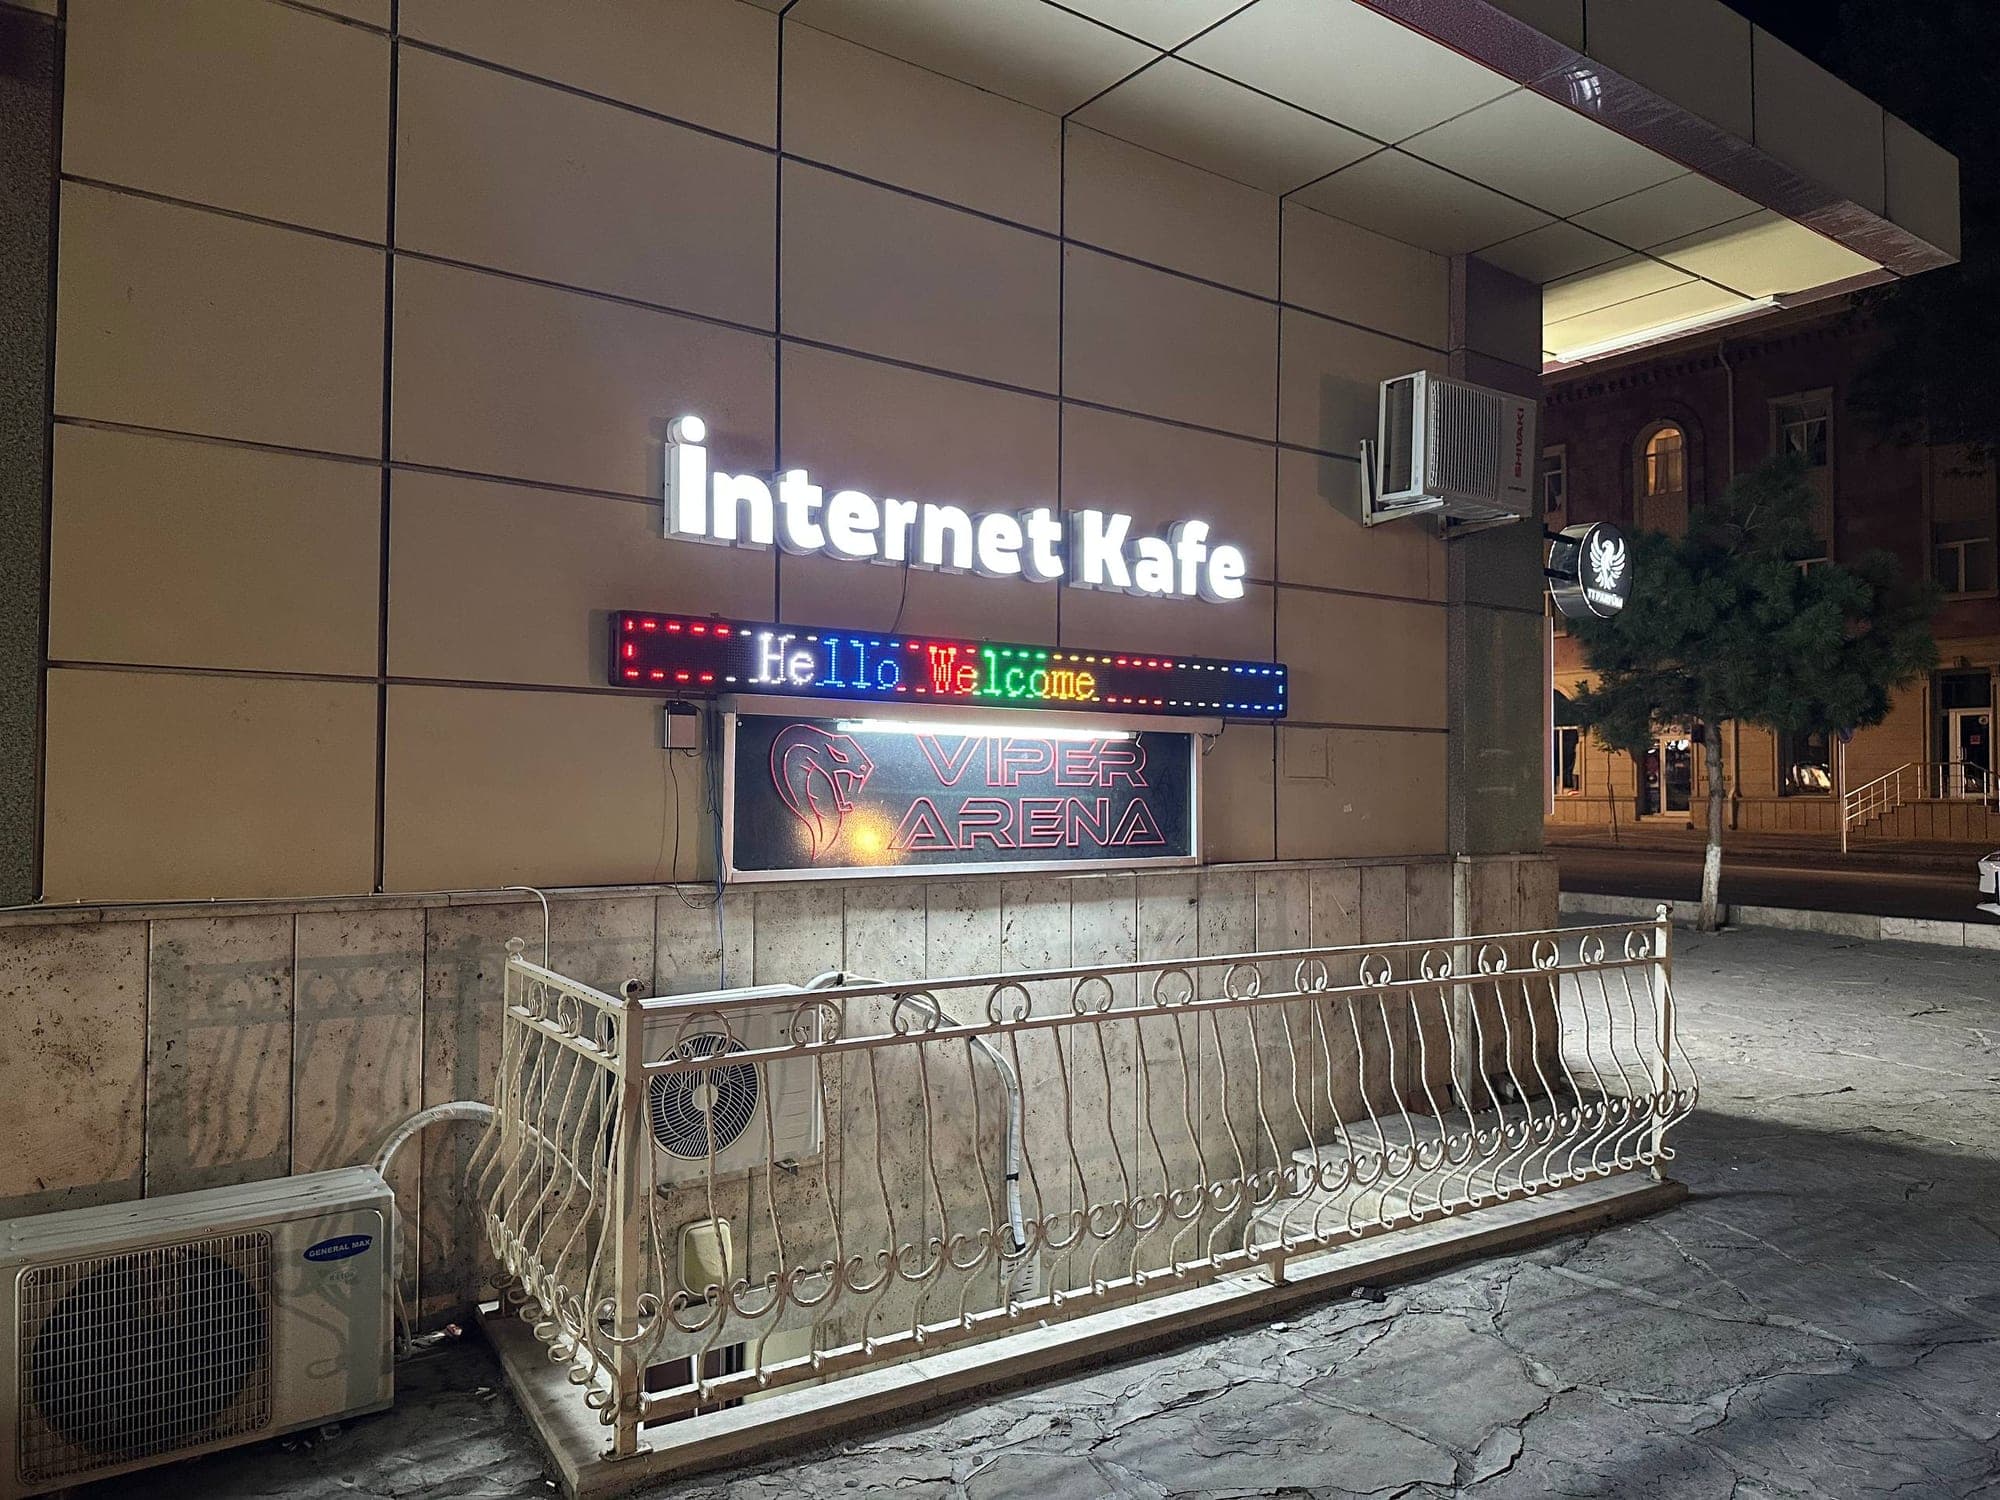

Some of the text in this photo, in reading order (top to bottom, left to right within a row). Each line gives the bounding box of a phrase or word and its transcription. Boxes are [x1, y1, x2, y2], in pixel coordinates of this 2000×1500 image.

[1515, 408, 1524, 477] SHIVAKI
[1076, 510, 1246, 600] Kafe
[758, 632, 1096, 700] Hello Welcome
[916, 733, 1148, 788] VIPER
[887, 796, 1166, 850] ARENA
[309, 1239, 371, 1257] GENERAL MAX
